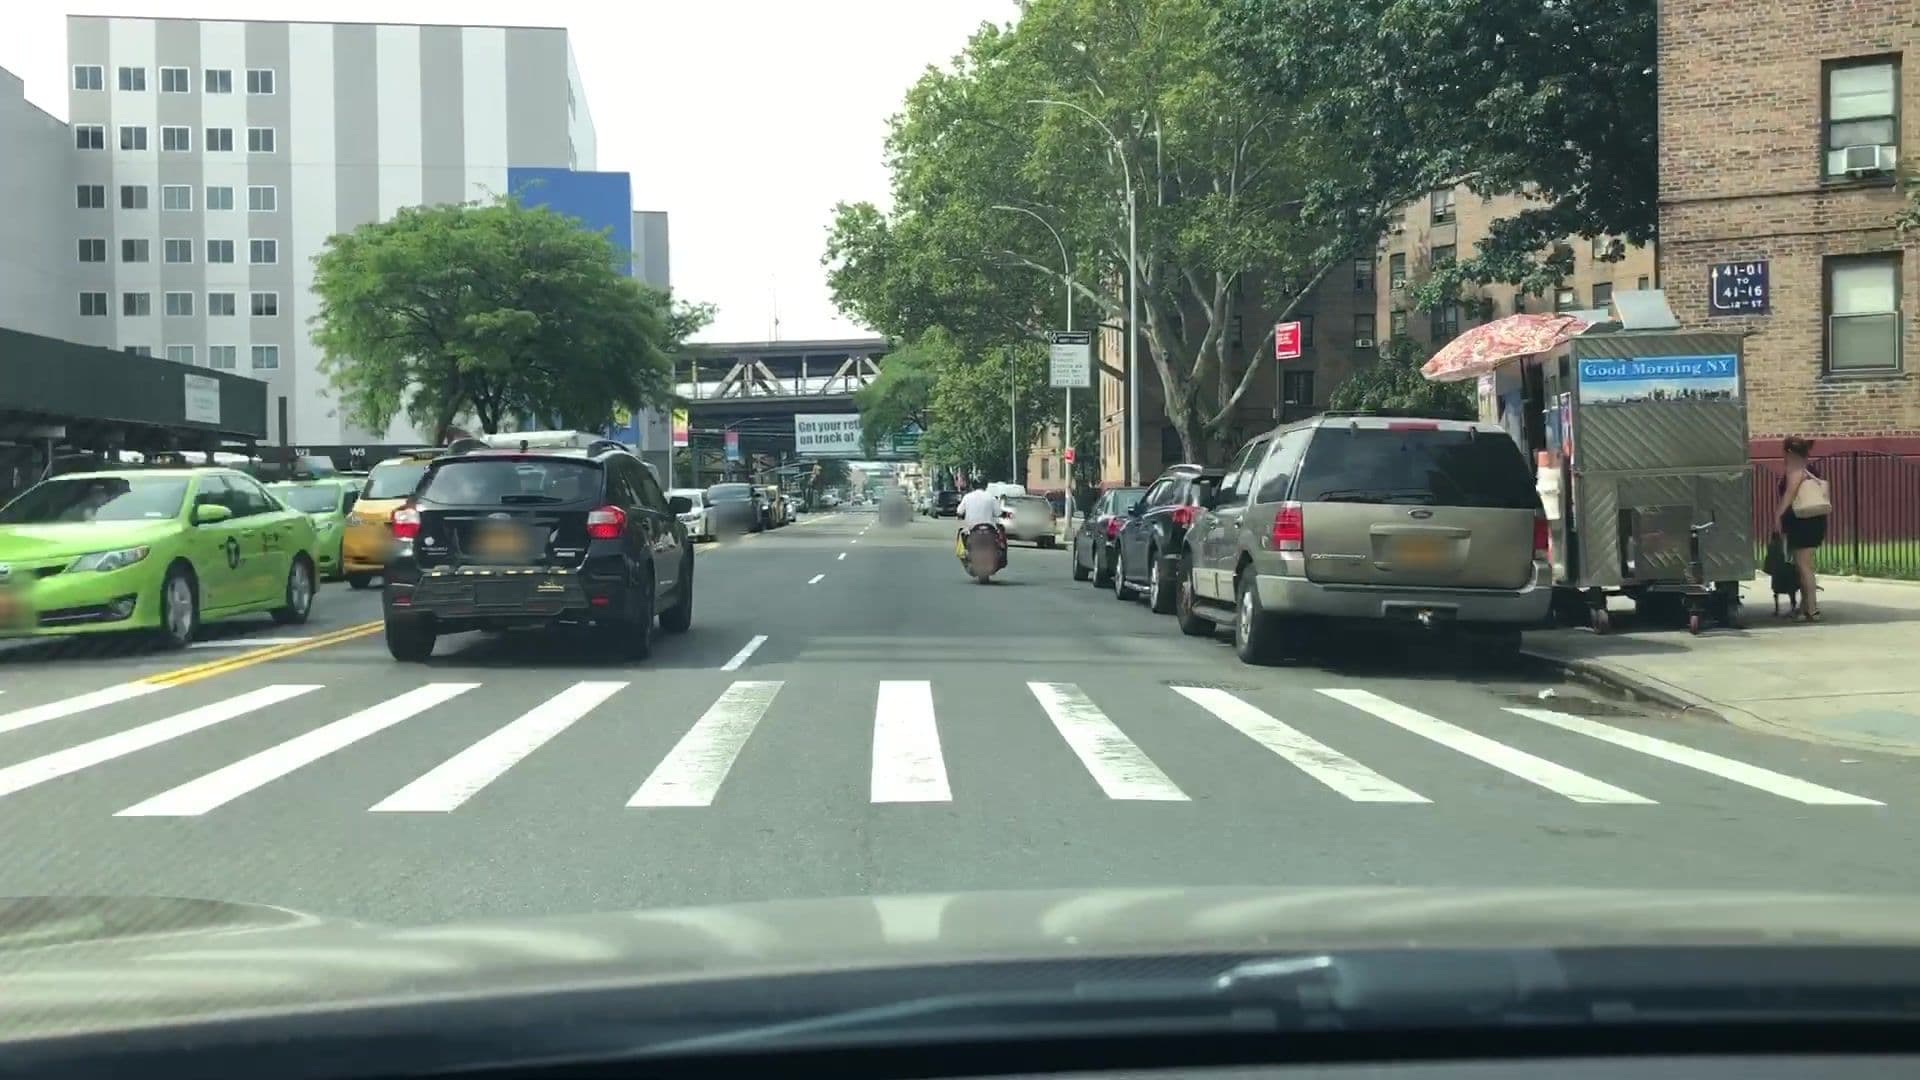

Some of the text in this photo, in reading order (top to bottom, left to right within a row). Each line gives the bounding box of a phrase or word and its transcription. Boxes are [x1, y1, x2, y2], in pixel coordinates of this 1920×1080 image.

[1723, 264, 1762, 276] 41-01
[1736, 277, 1749, 285] TO
[1723, 286, 1762, 298] 41-16
[1584, 359, 1730, 376] Good Morning NY
[799, 421, 816, 432] Get
[819, 421, 841, 433] your
[800, 431, 855, 445] on track at
